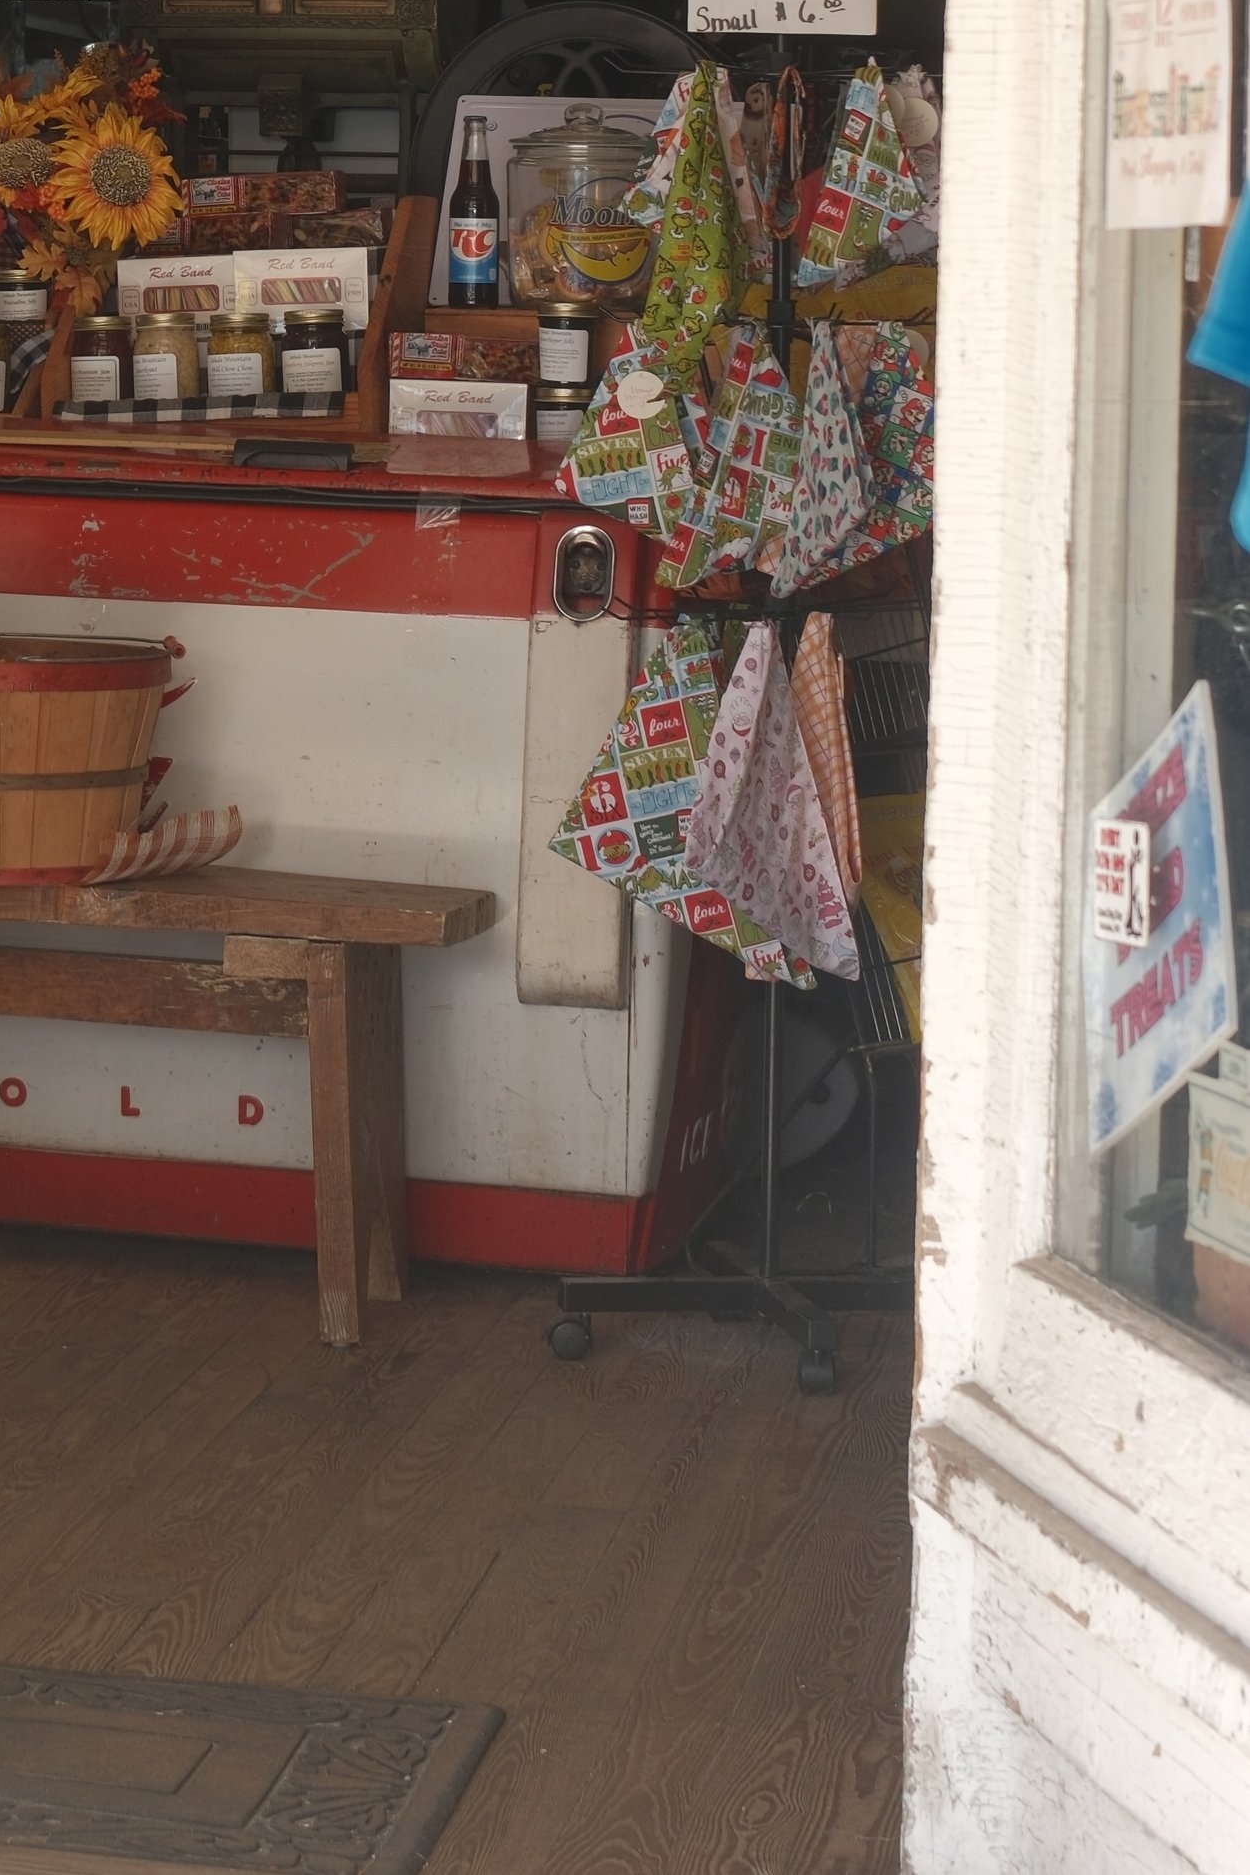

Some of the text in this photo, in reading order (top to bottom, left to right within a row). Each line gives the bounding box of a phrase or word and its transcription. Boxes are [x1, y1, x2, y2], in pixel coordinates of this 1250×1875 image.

[695, 6, 759, 33] Small
[817, 199, 846, 221] four
[451, 227, 496, 259] RC
[148, 265, 214, 281] Red Band
[268, 257, 336, 272] Red Band
[424, 389, 496, 405] Red Band
[575, 436, 642, 460] SEVEN
[591, 471, 642, 502] EIGHT
[629, 504, 647, 512] WHO
[629, 513, 648, 521] HASH
[649, 717, 683, 737] four
[623, 745, 689, 772] SEVEN
[639, 781, 692, 815] EIGHT
[693, 903, 727, 925] four
[1109, 916, 1205, 1061] TREATS
